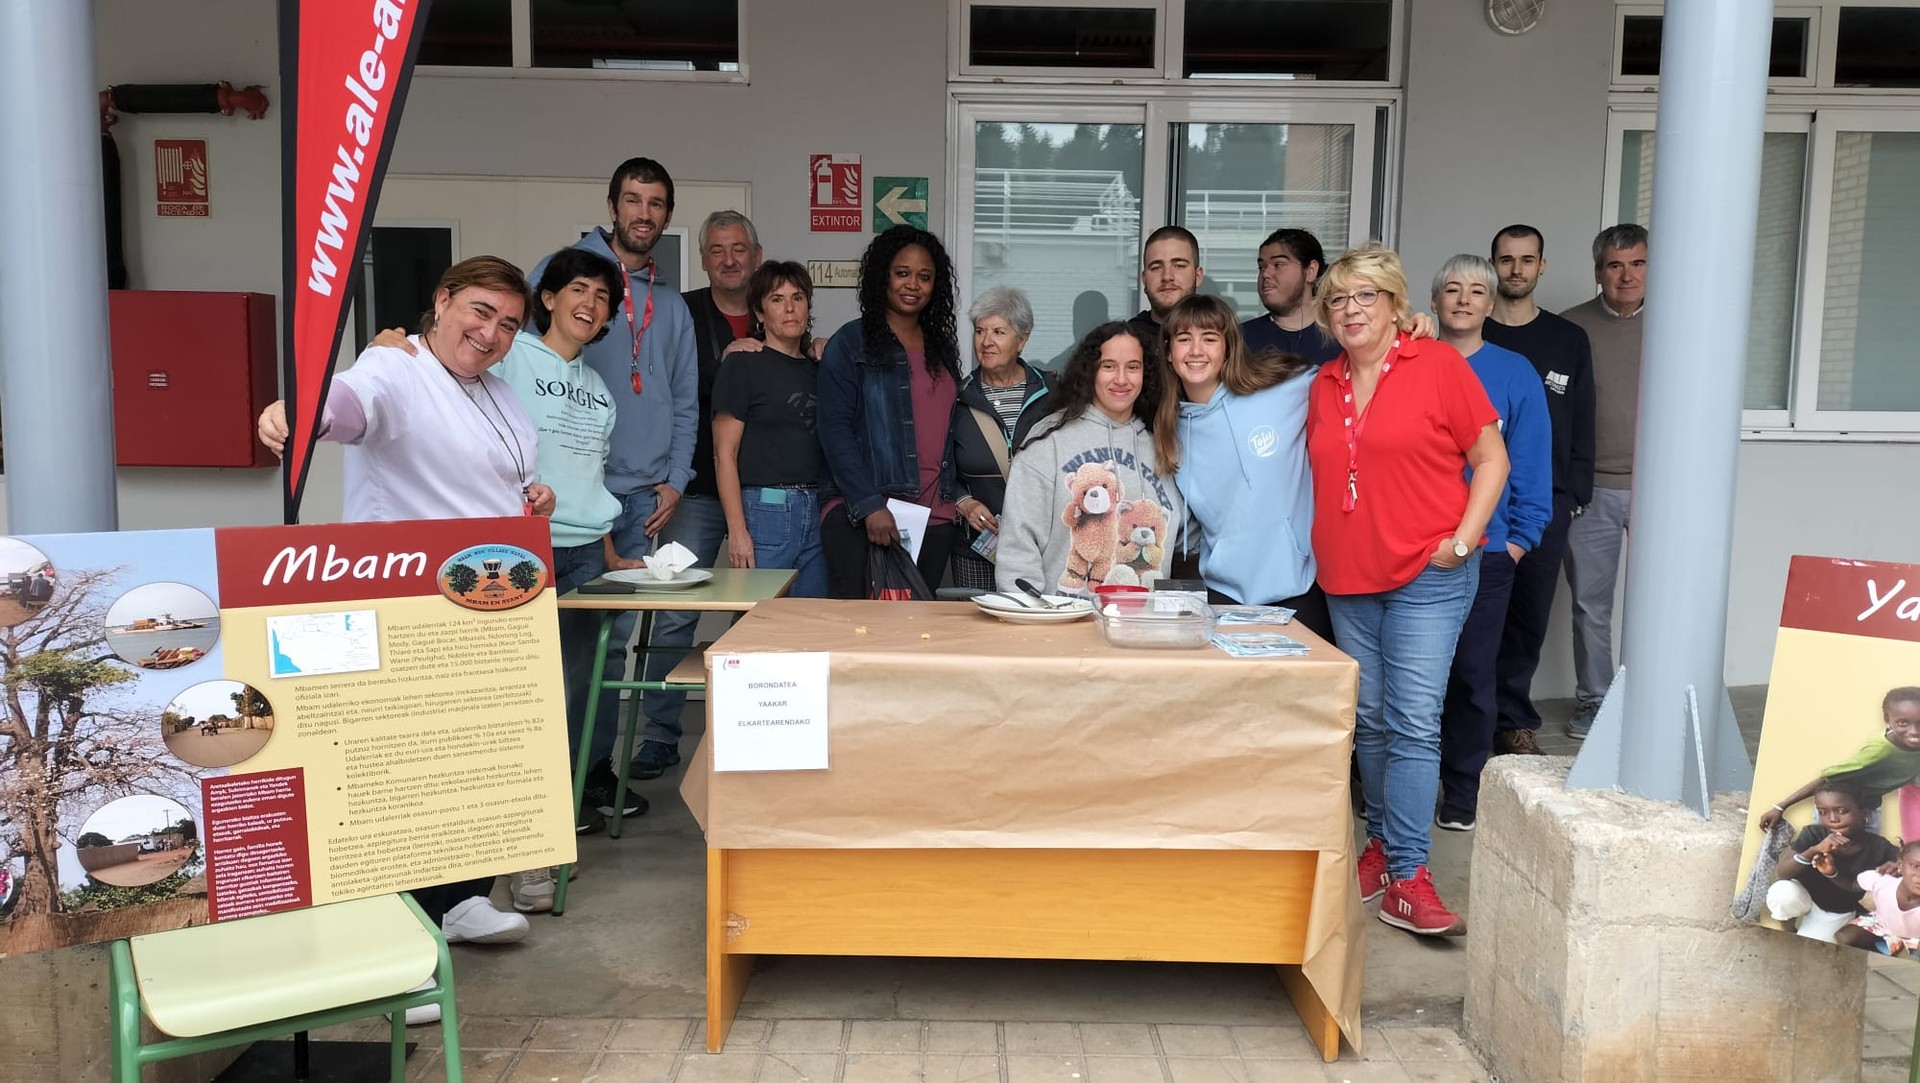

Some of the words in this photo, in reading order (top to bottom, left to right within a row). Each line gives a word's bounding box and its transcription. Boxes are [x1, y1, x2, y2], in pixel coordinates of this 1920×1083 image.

[308, 0, 405, 296] www.ale-a
[812, 215, 860, 226] EXTINTOR
[810, 262, 833, 284] 114
[535, 378, 609, 411] SORGIN
[1061, 447, 1136, 473] WANNA
[262, 544, 427, 586] Mbam
[748, 681, 797, 689] BORONDATEA
[738, 718, 810, 727] ELKARTEARENDAKO
